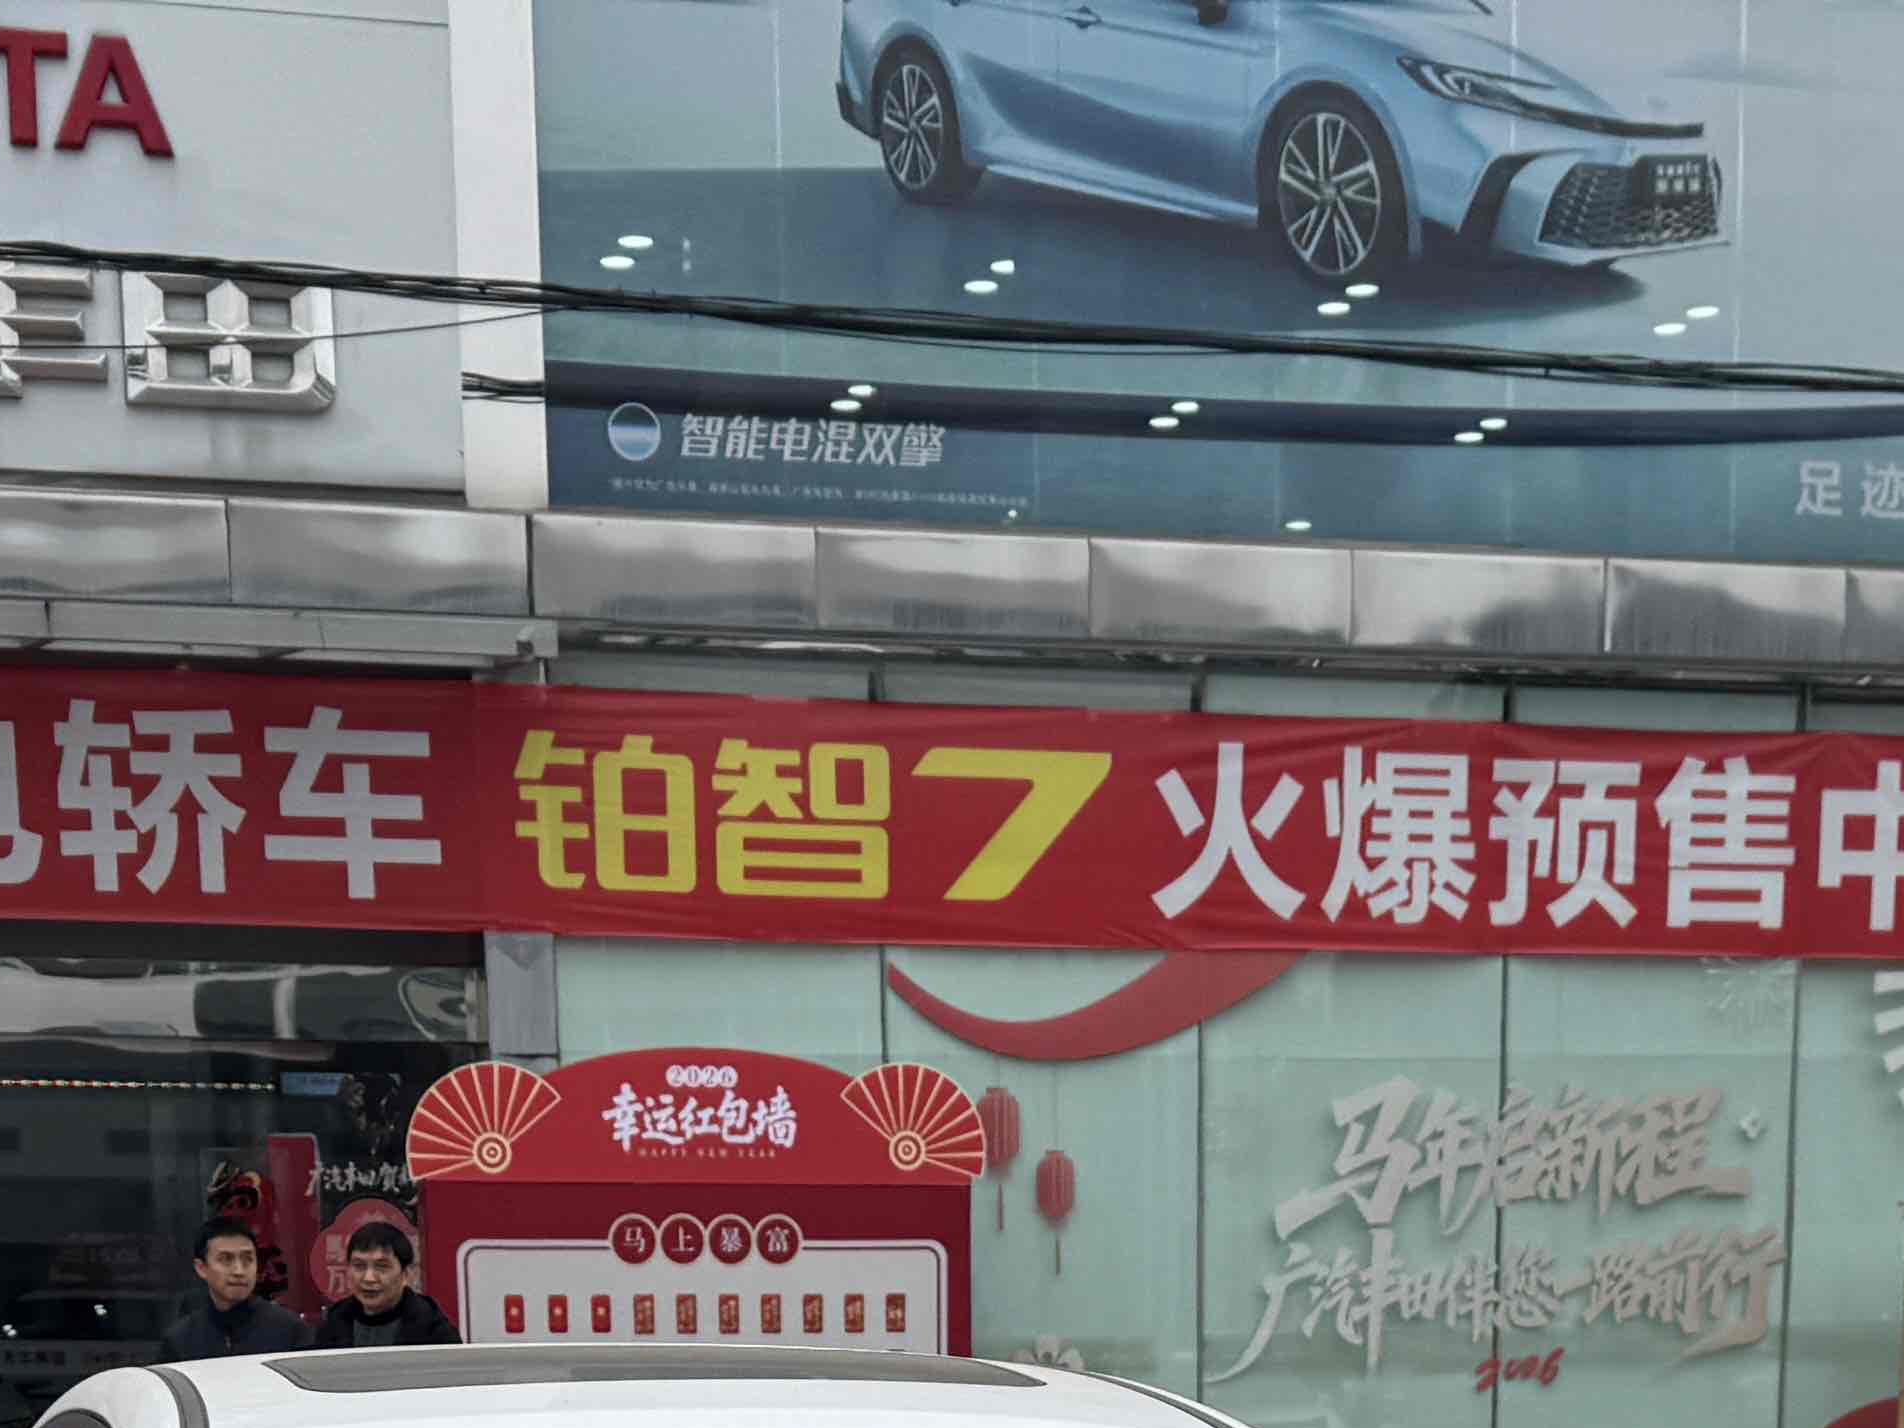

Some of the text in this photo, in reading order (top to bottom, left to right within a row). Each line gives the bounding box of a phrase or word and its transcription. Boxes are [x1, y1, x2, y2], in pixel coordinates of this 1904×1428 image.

[679, 412, 946, 467] 智能电混双擎
[515, 729, 1112, 906] 铂智7
[601, 1082, 797, 1152] 幸运红包墙
[1275, 1075, 1752, 1239] 马年启新程
[624, 1225, 790, 1253] 马上暴富
